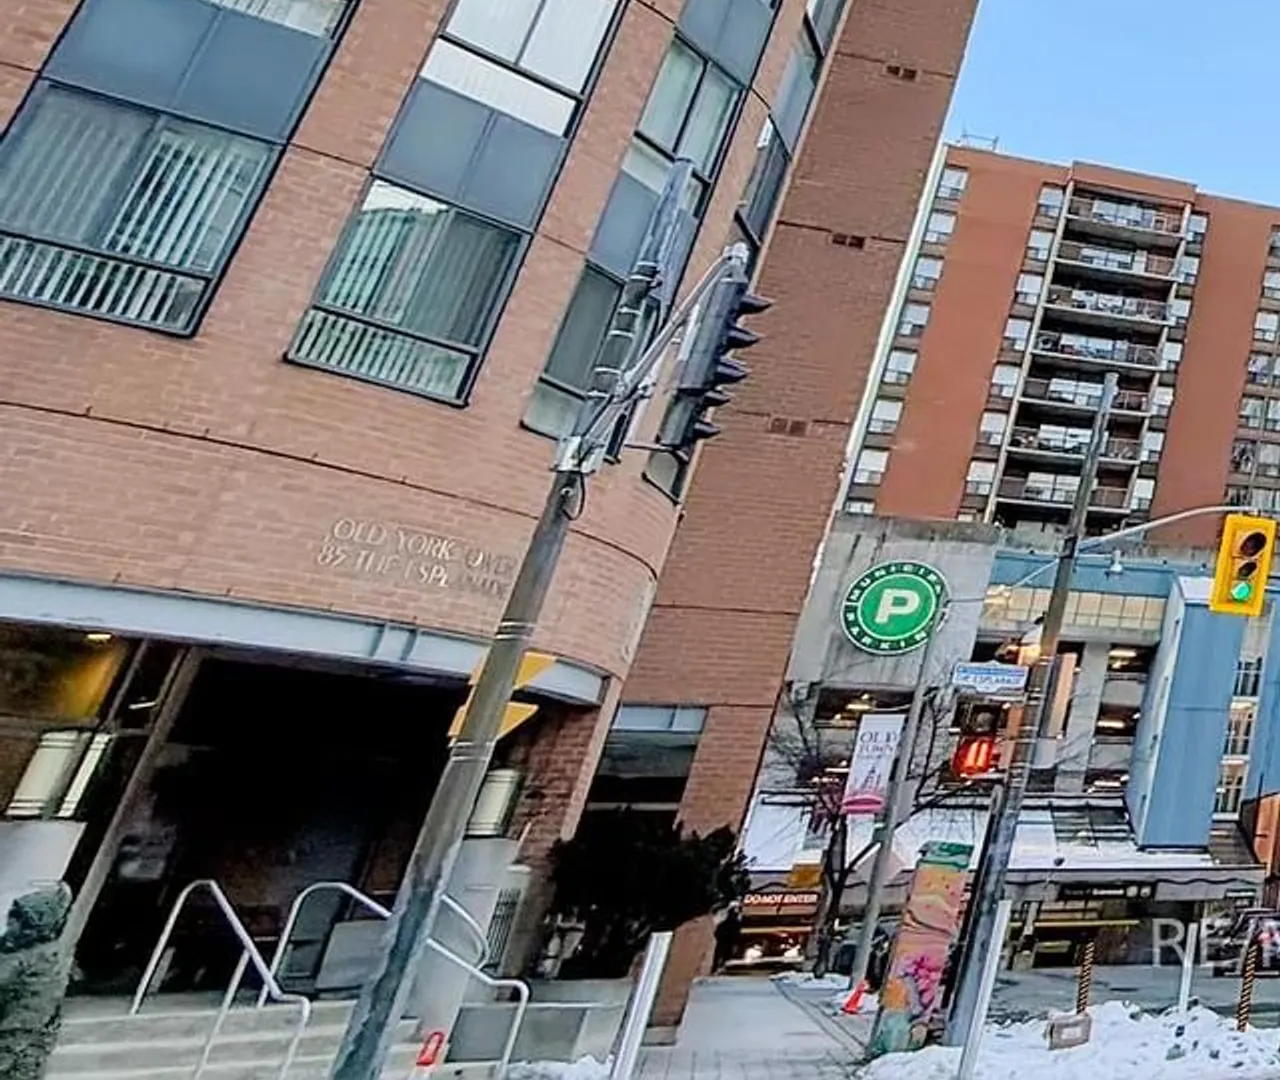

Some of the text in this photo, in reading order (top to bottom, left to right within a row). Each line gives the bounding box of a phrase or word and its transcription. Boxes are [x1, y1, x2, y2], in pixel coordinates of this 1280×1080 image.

[333, 519, 387, 545] OLD
[397, 529, 455, 561] YORK
[874, 588, 920, 624] P
